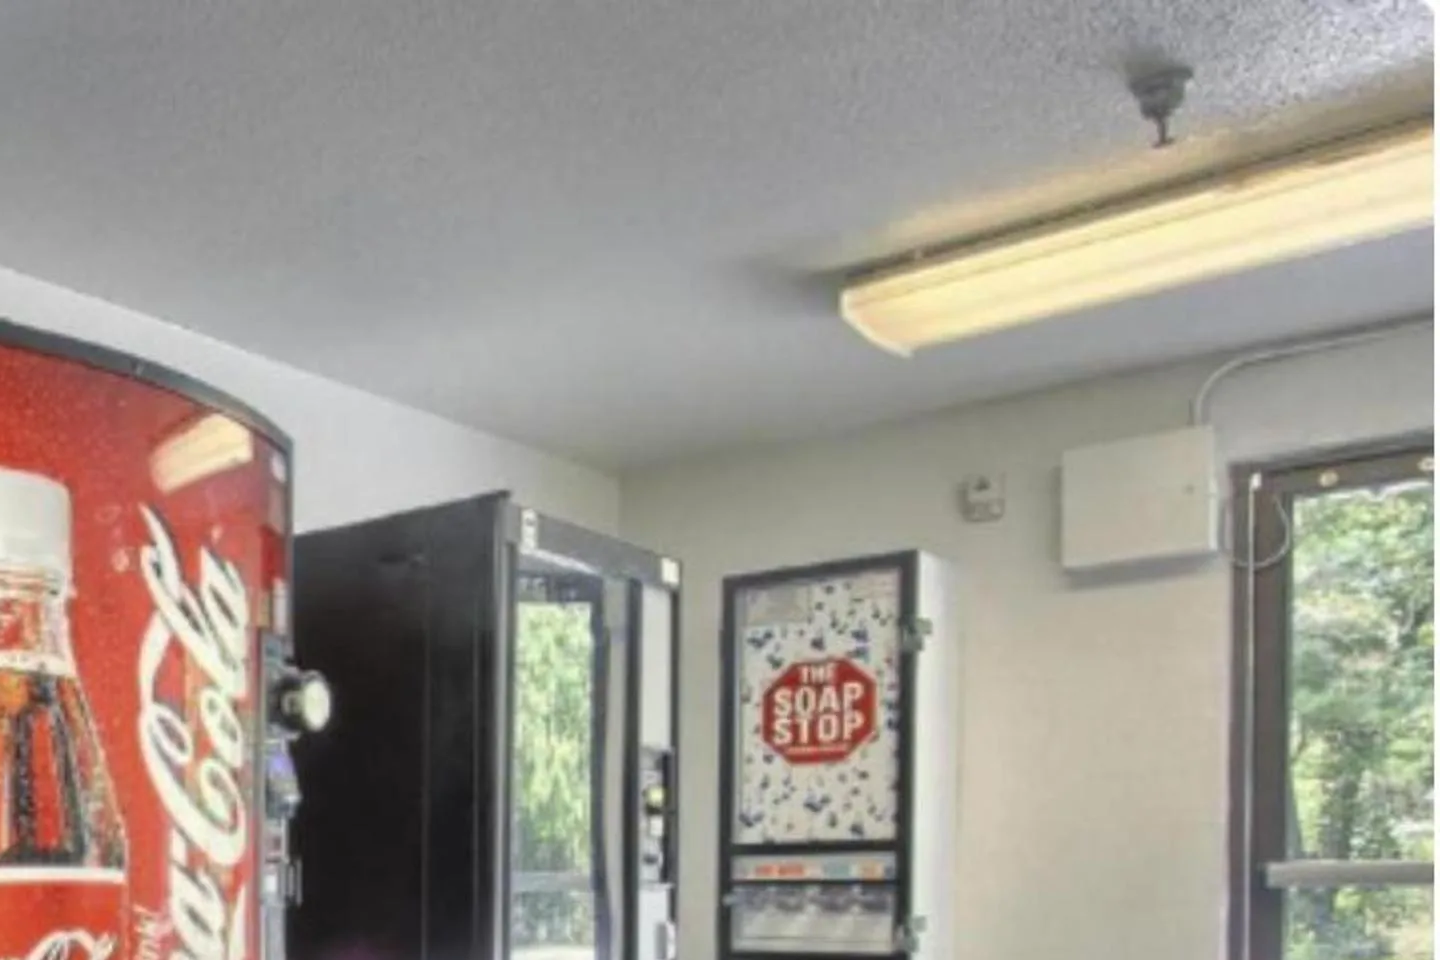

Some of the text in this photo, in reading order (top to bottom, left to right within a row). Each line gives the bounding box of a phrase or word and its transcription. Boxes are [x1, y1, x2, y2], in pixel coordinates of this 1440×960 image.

[799, 662, 838, 685] THE
[773, 681, 864, 719] SOAP
[773, 710, 866, 745] STOP
